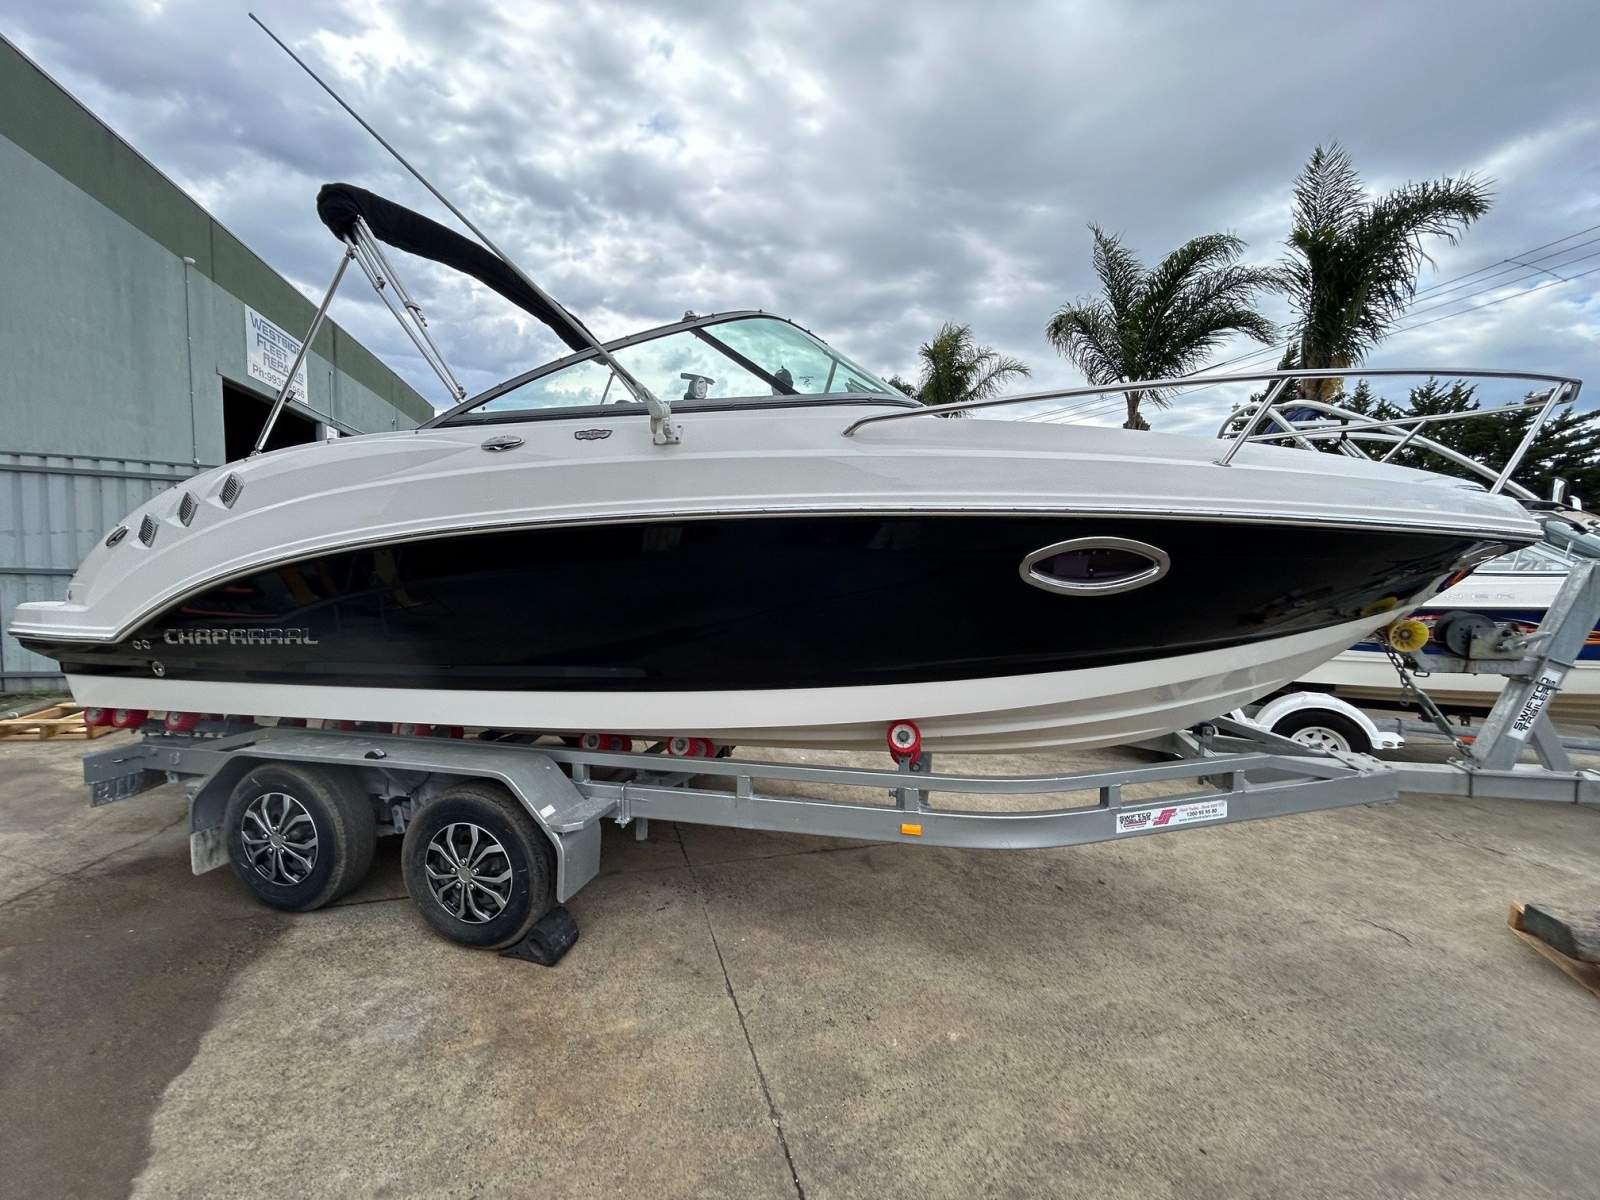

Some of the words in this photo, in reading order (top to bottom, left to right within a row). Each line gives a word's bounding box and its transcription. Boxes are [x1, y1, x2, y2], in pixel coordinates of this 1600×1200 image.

[257, 333, 288, 363] FLEET
[263, 352, 304, 383] REPAS
[164, 628, 318, 645] CHAPARRAL
